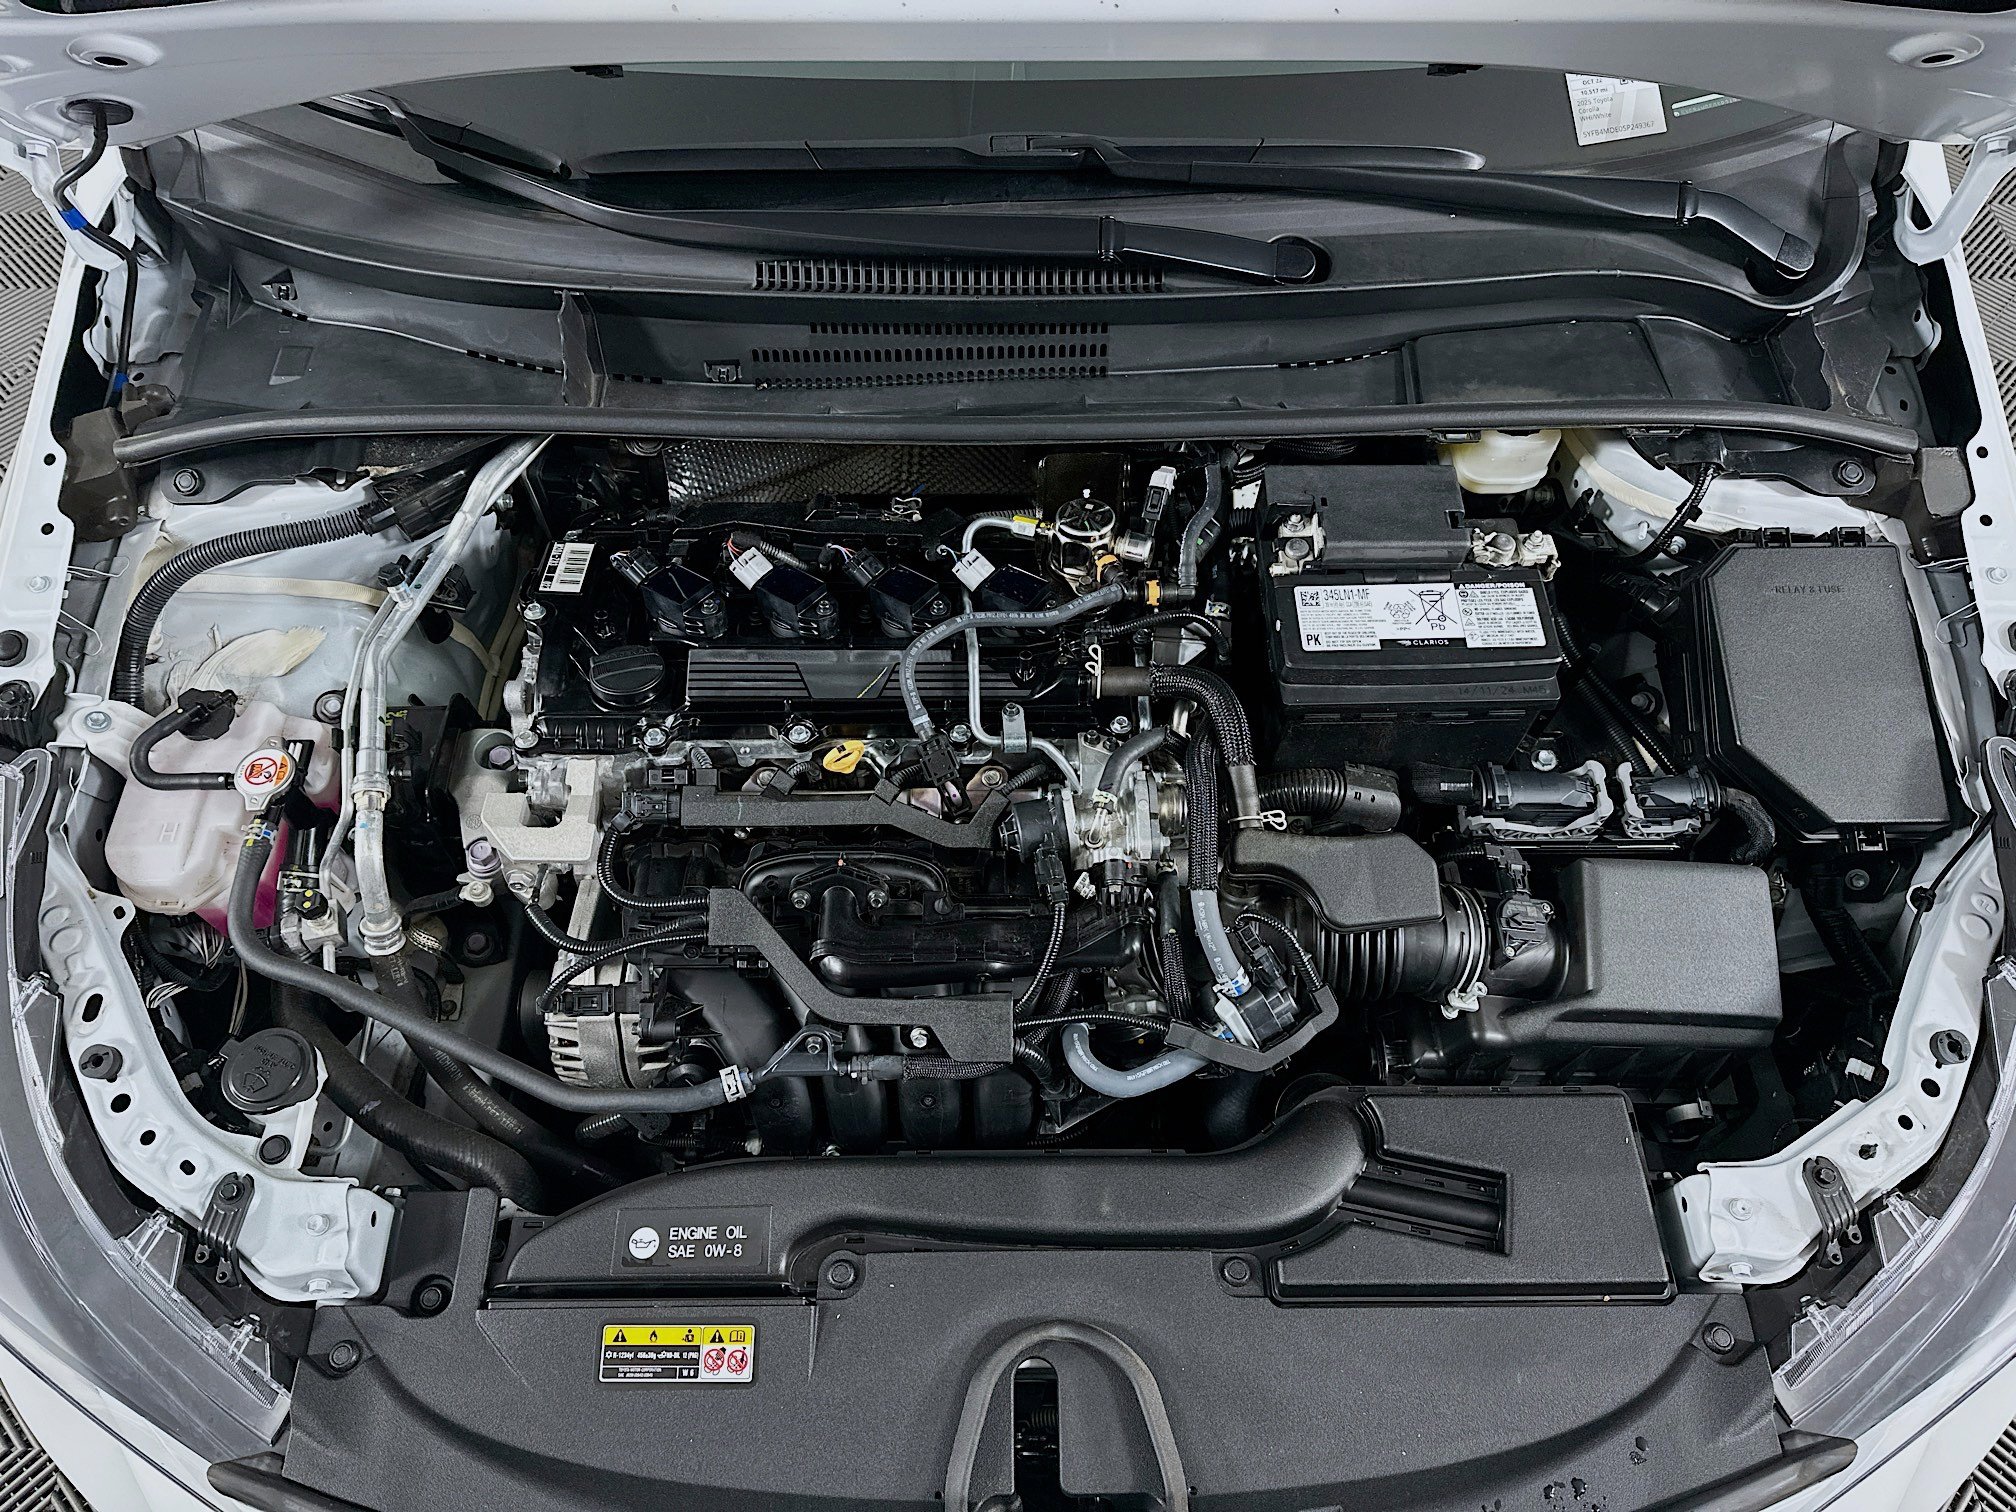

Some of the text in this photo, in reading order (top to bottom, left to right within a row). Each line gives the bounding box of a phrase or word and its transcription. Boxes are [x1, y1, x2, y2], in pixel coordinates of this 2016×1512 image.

[1576, 96, 1614, 107] 2025 Toyota
[1578, 106, 1600, 115] Corolla
[1323, 588, 1370, 601] 345LN1-MF
[1430, 622, 1446, 631] Pb
[1306, 634, 1322, 646] PK
[432, 1048, 464, 1082] NICHIRIN
[669, 1225, 748, 1241] ENGINE OIL
[667, 1243, 743, 1259] SAE 0W-8
